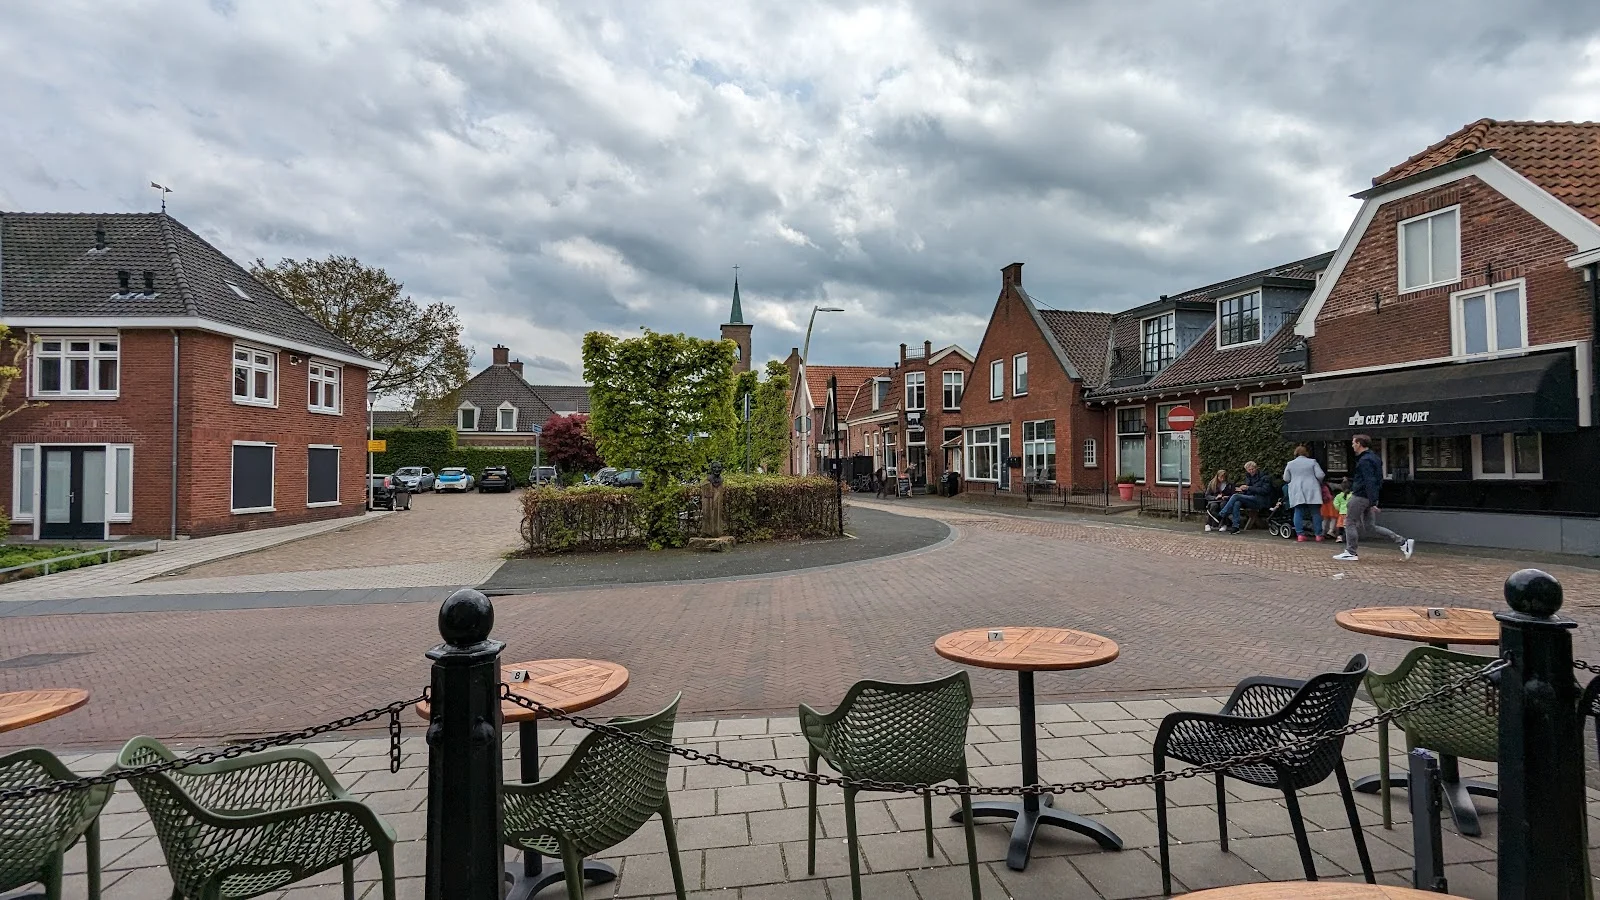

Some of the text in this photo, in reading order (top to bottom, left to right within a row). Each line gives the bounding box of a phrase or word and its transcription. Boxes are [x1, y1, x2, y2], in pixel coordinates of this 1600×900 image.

[1366, 412, 1429, 424] CAFÉ DE POORT
[515, 671, 520, 679] 8
